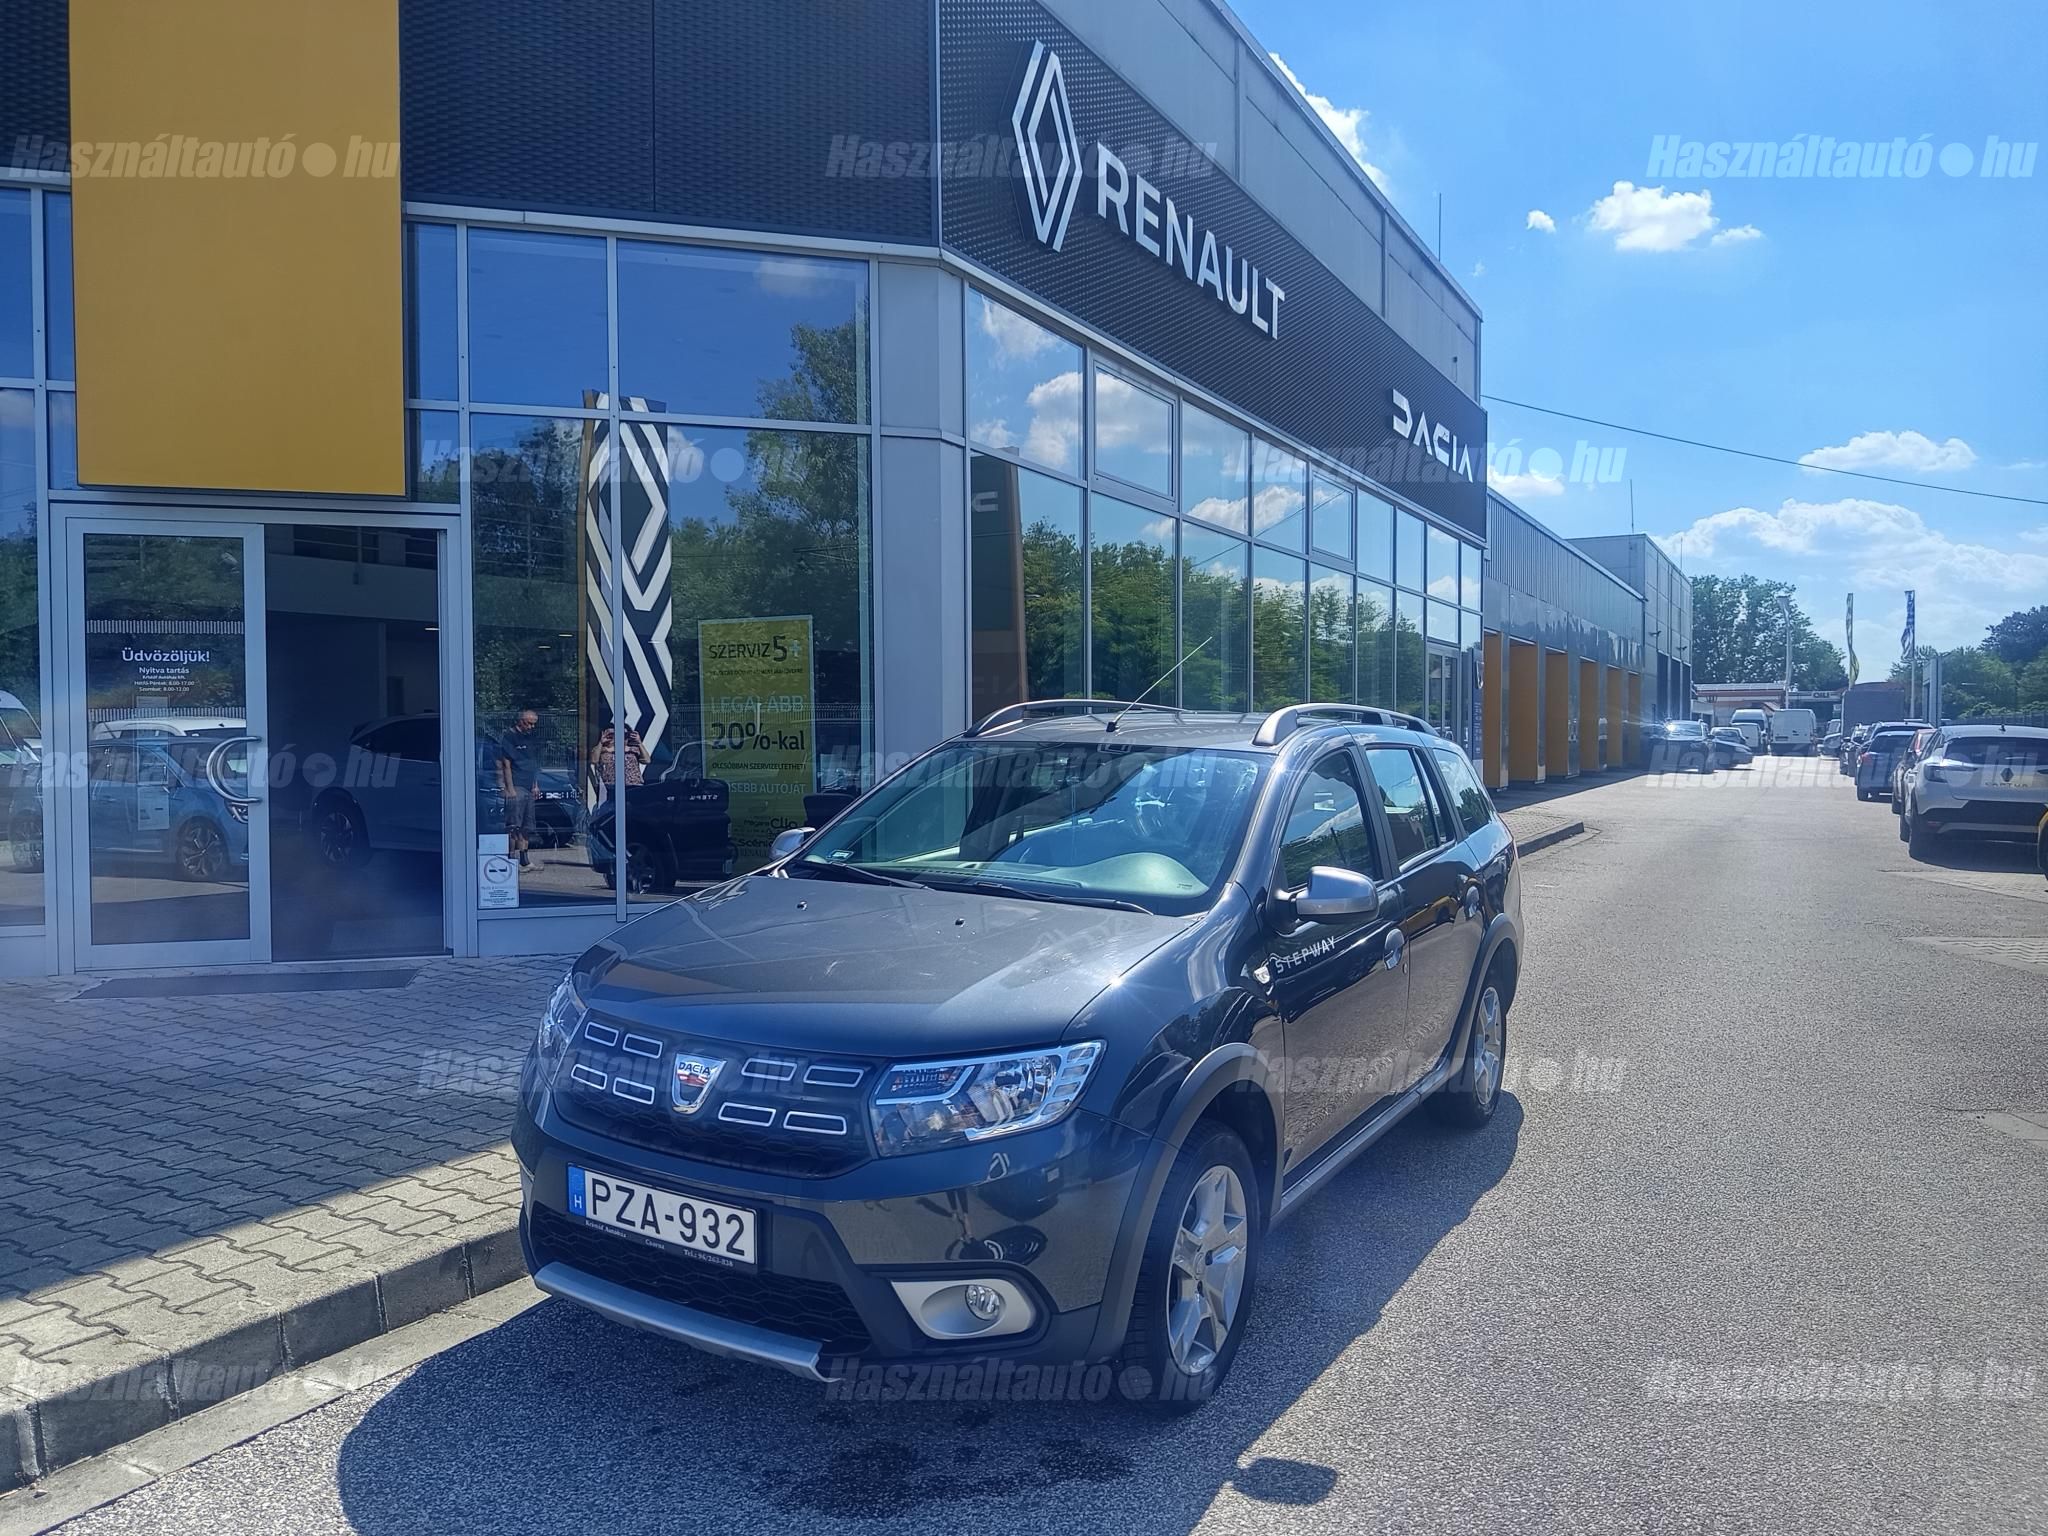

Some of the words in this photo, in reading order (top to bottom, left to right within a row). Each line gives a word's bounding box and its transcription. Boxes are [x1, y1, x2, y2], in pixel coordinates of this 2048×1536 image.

[1097, 141, 1286, 340] RENAULT
[1393, 388, 1474, 483] DACIA
[121, 647, 210, 665] Üdvözöljük!
[708, 643, 771, 659] SZERVIZ
[139, 667, 165, 675] Nyitva
[711, 722, 806, 750] 20%-kal
[1275, 935, 1336, 974] STEPWAY
[678, 1061, 711, 1076] DACIA
[574, 1194, 582, 1210] H
[591, 1177, 745, 1257] PZA-932
